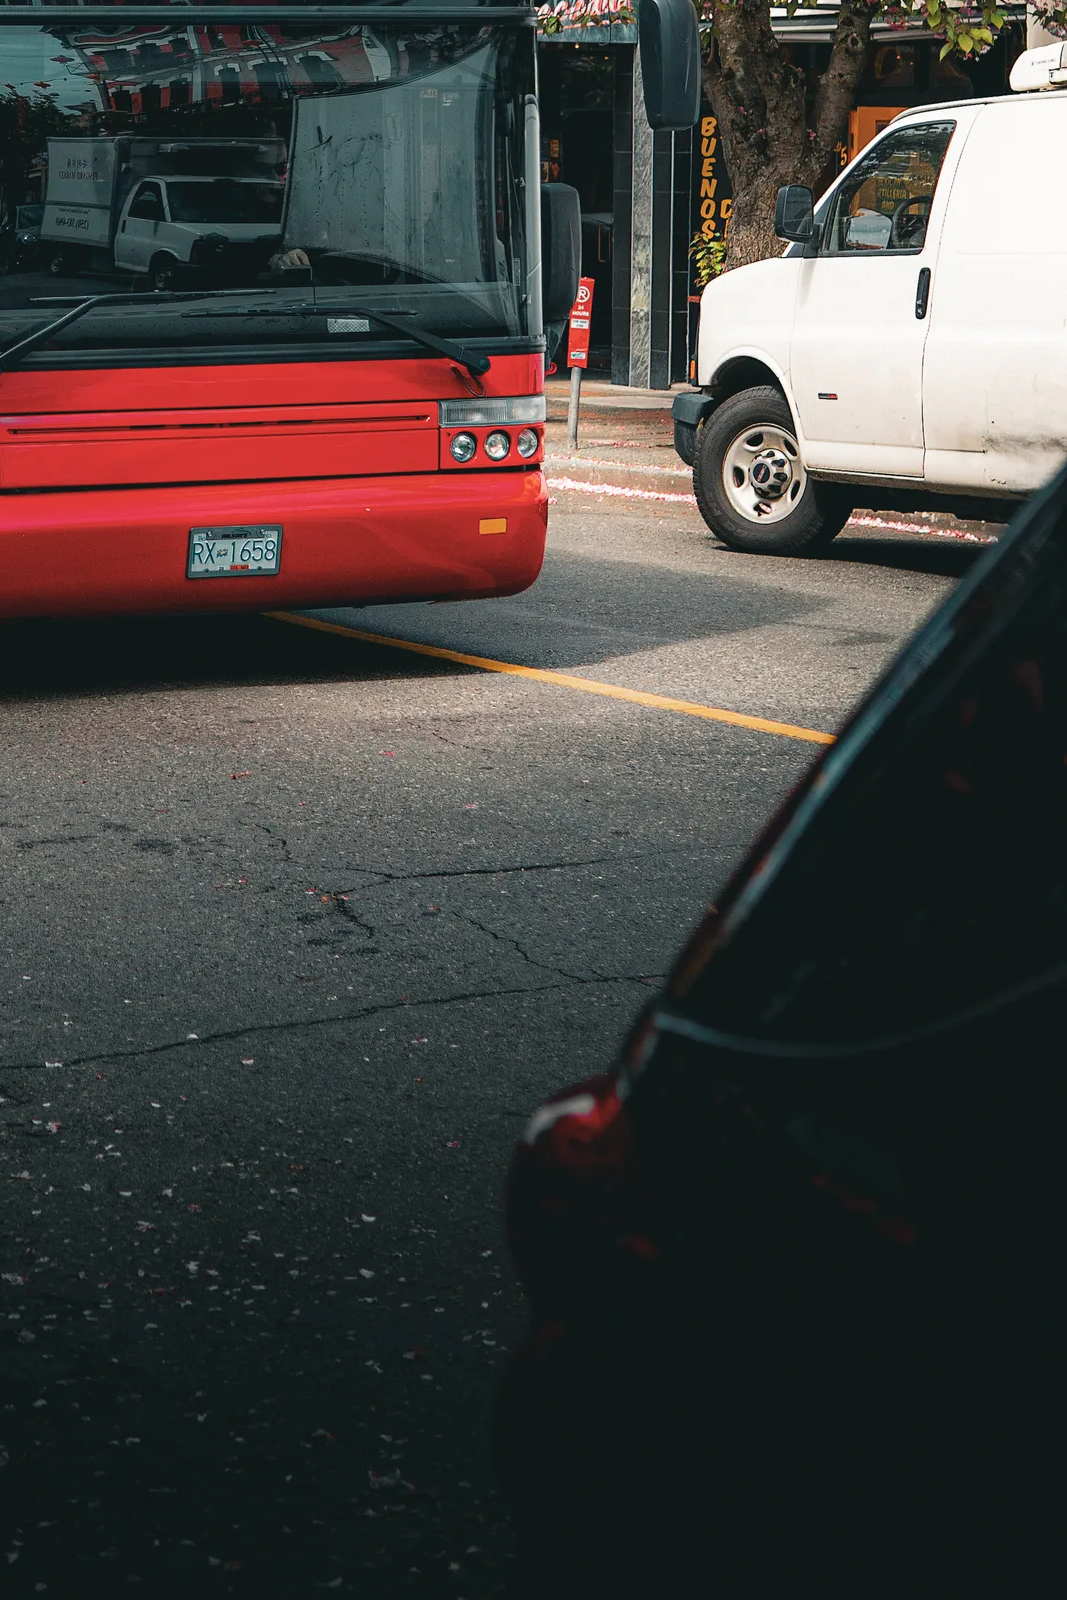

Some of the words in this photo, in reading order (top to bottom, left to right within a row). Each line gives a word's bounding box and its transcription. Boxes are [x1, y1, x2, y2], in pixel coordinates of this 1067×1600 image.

[700, 116, 718, 239] BUENOS
[192, 542, 216, 565] RX
[231, 539, 276, 563] 1658
